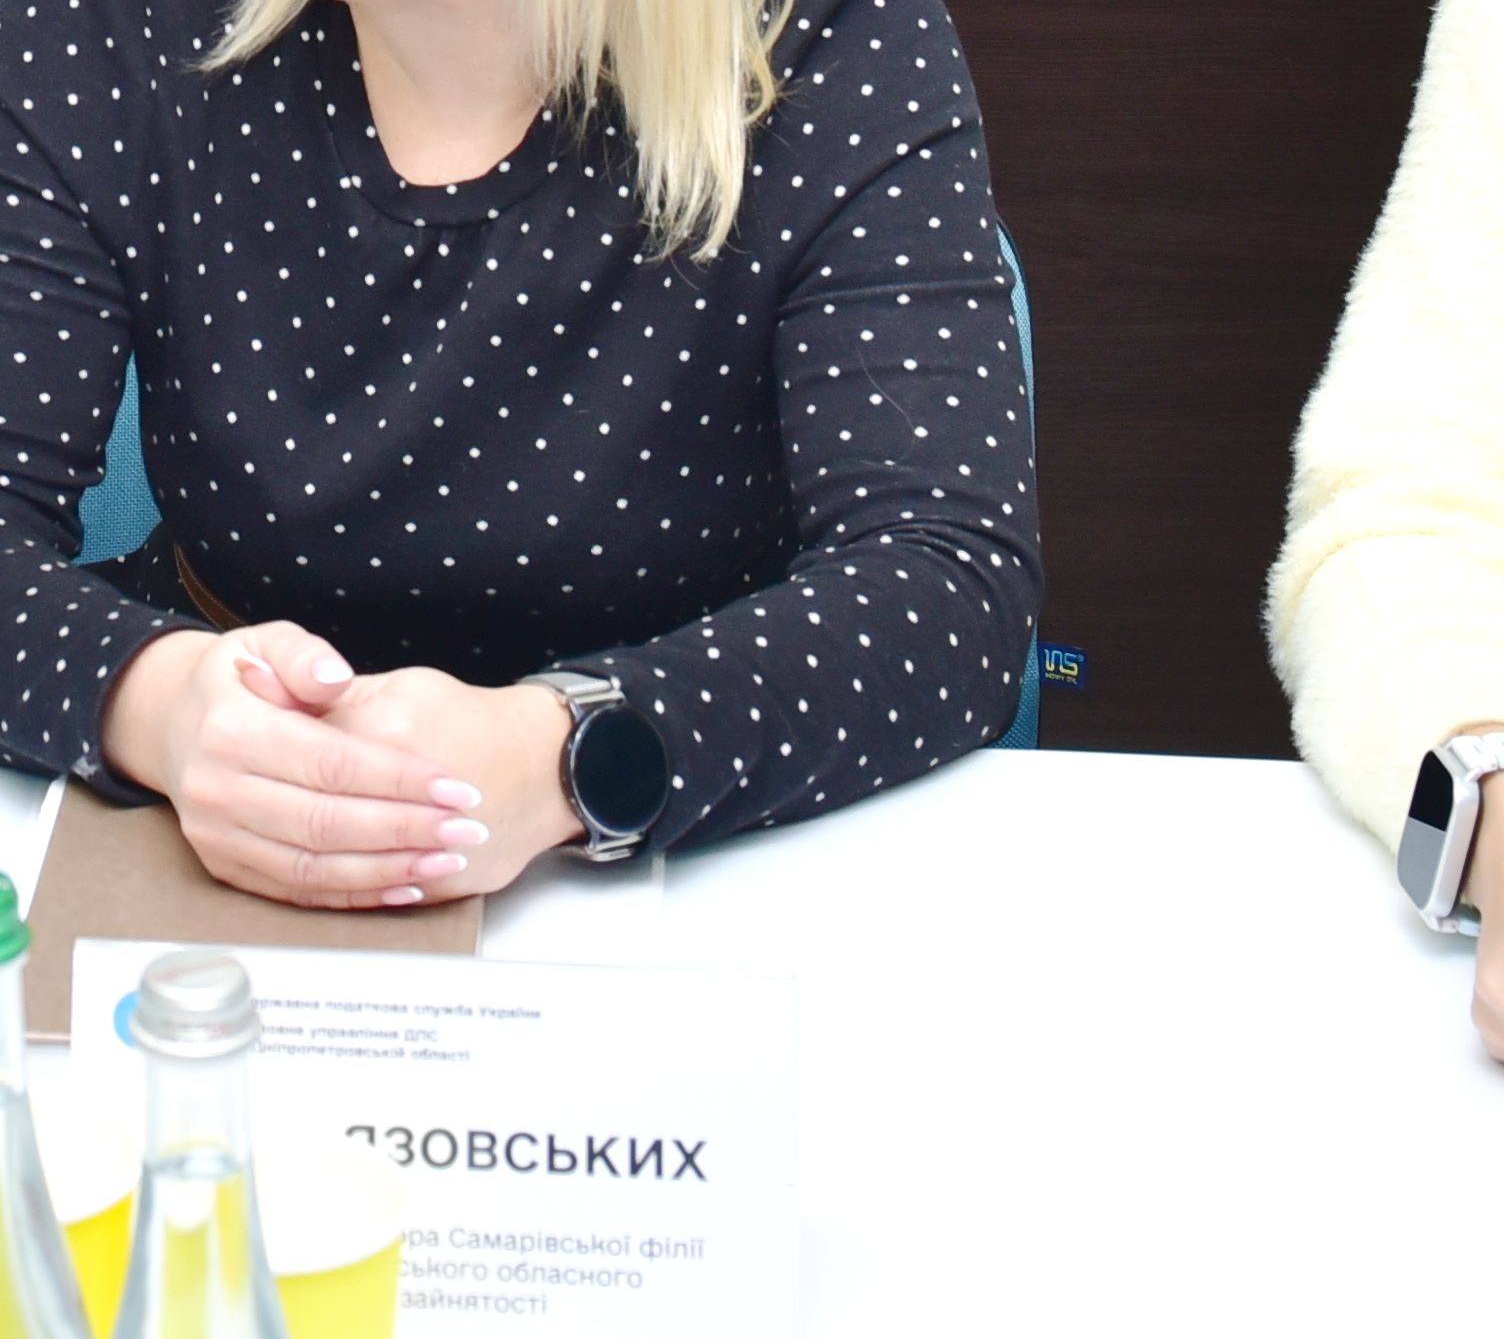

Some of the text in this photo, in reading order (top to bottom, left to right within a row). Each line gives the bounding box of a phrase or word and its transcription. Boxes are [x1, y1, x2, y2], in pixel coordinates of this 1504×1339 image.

[449, 1228, 630, 1256] Самарівської
[639, 1237, 704, 1261] філії
[496, 1261, 644, 1289] обласного
